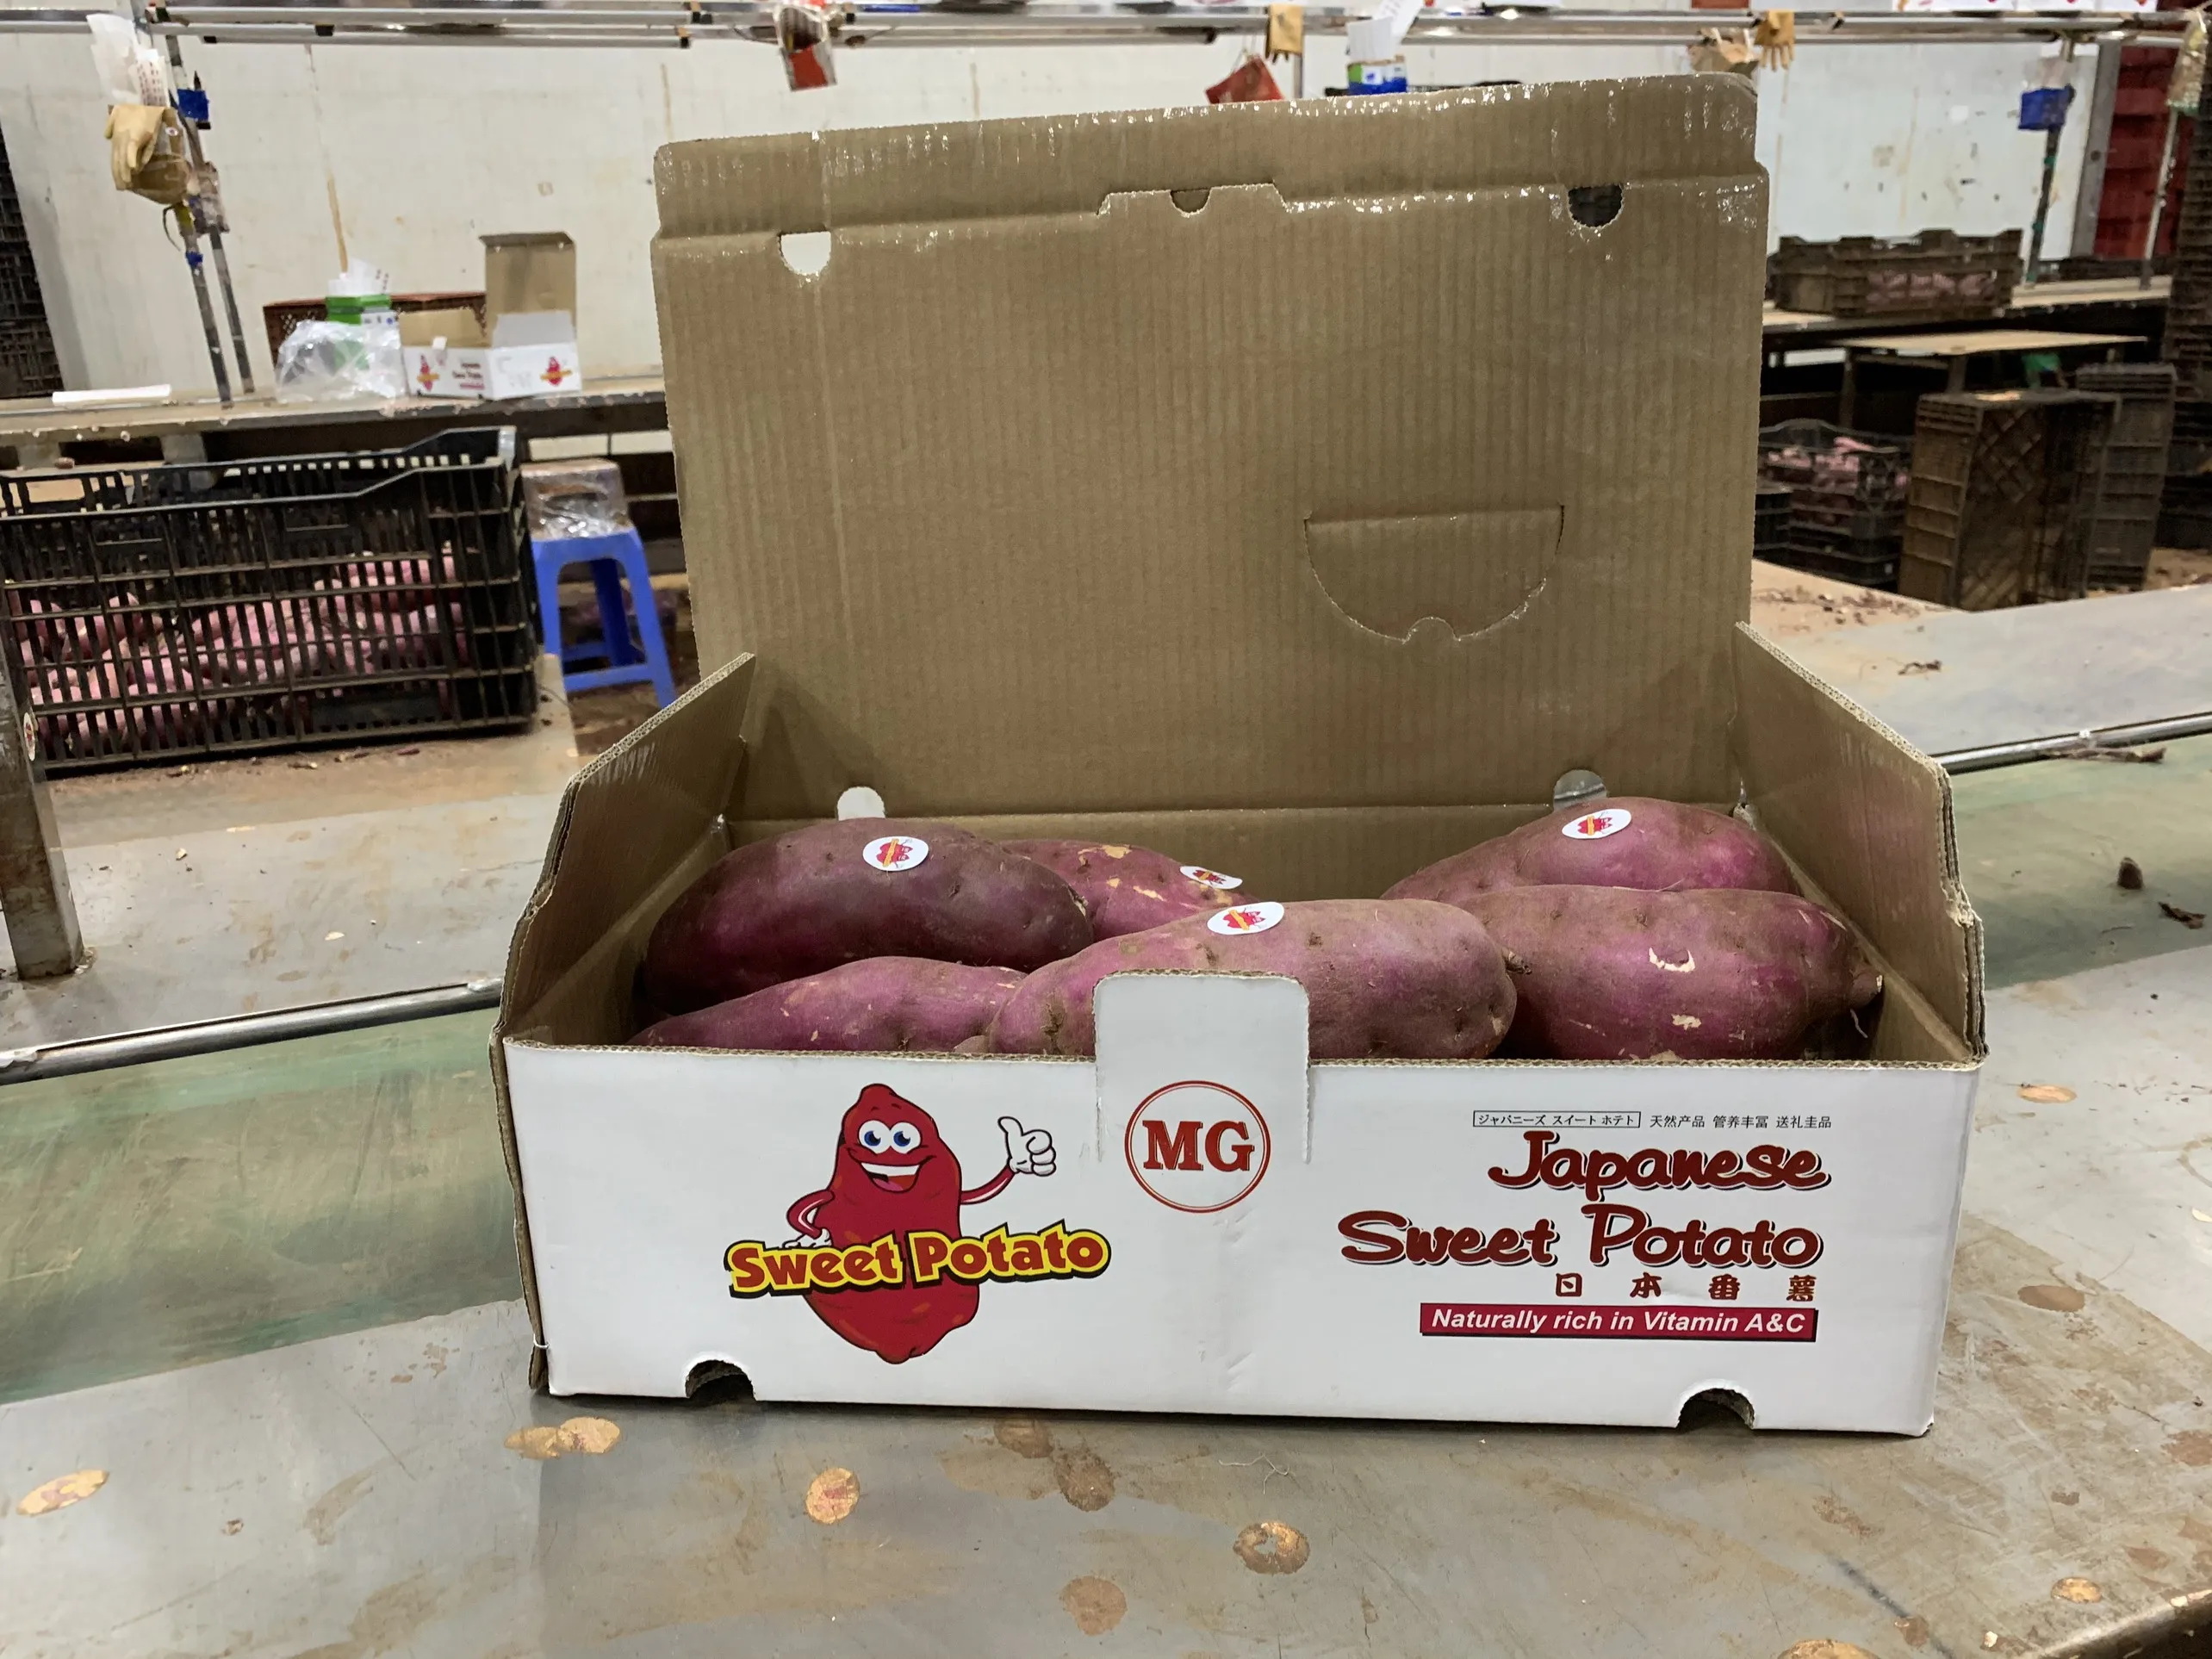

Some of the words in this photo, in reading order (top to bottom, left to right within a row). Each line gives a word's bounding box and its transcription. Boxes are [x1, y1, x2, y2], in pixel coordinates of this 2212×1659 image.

[1142, 1120, 1255, 1172] MG
[1552, 1114, 1598, 1127] スイート
[1649, 1115, 1706, 1128] 天然产品
[1488, 1130, 1832, 1202] Japanese
[726, 1228, 903, 1295] Sweet
[910, 1221, 1109, 1284] Potato
[1337, 1209, 1560, 1268] Sweet
[1580, 1202, 1824, 1269] Potato
[1431, 1308, 1547, 1334] Naturally
[1552, 1310, 1603, 1331] rich
[1610, 1310, 1635, 1332] in
[1643, 1310, 1739, 1333] Vitamin
[1744, 1312, 1806, 1333] A&C
